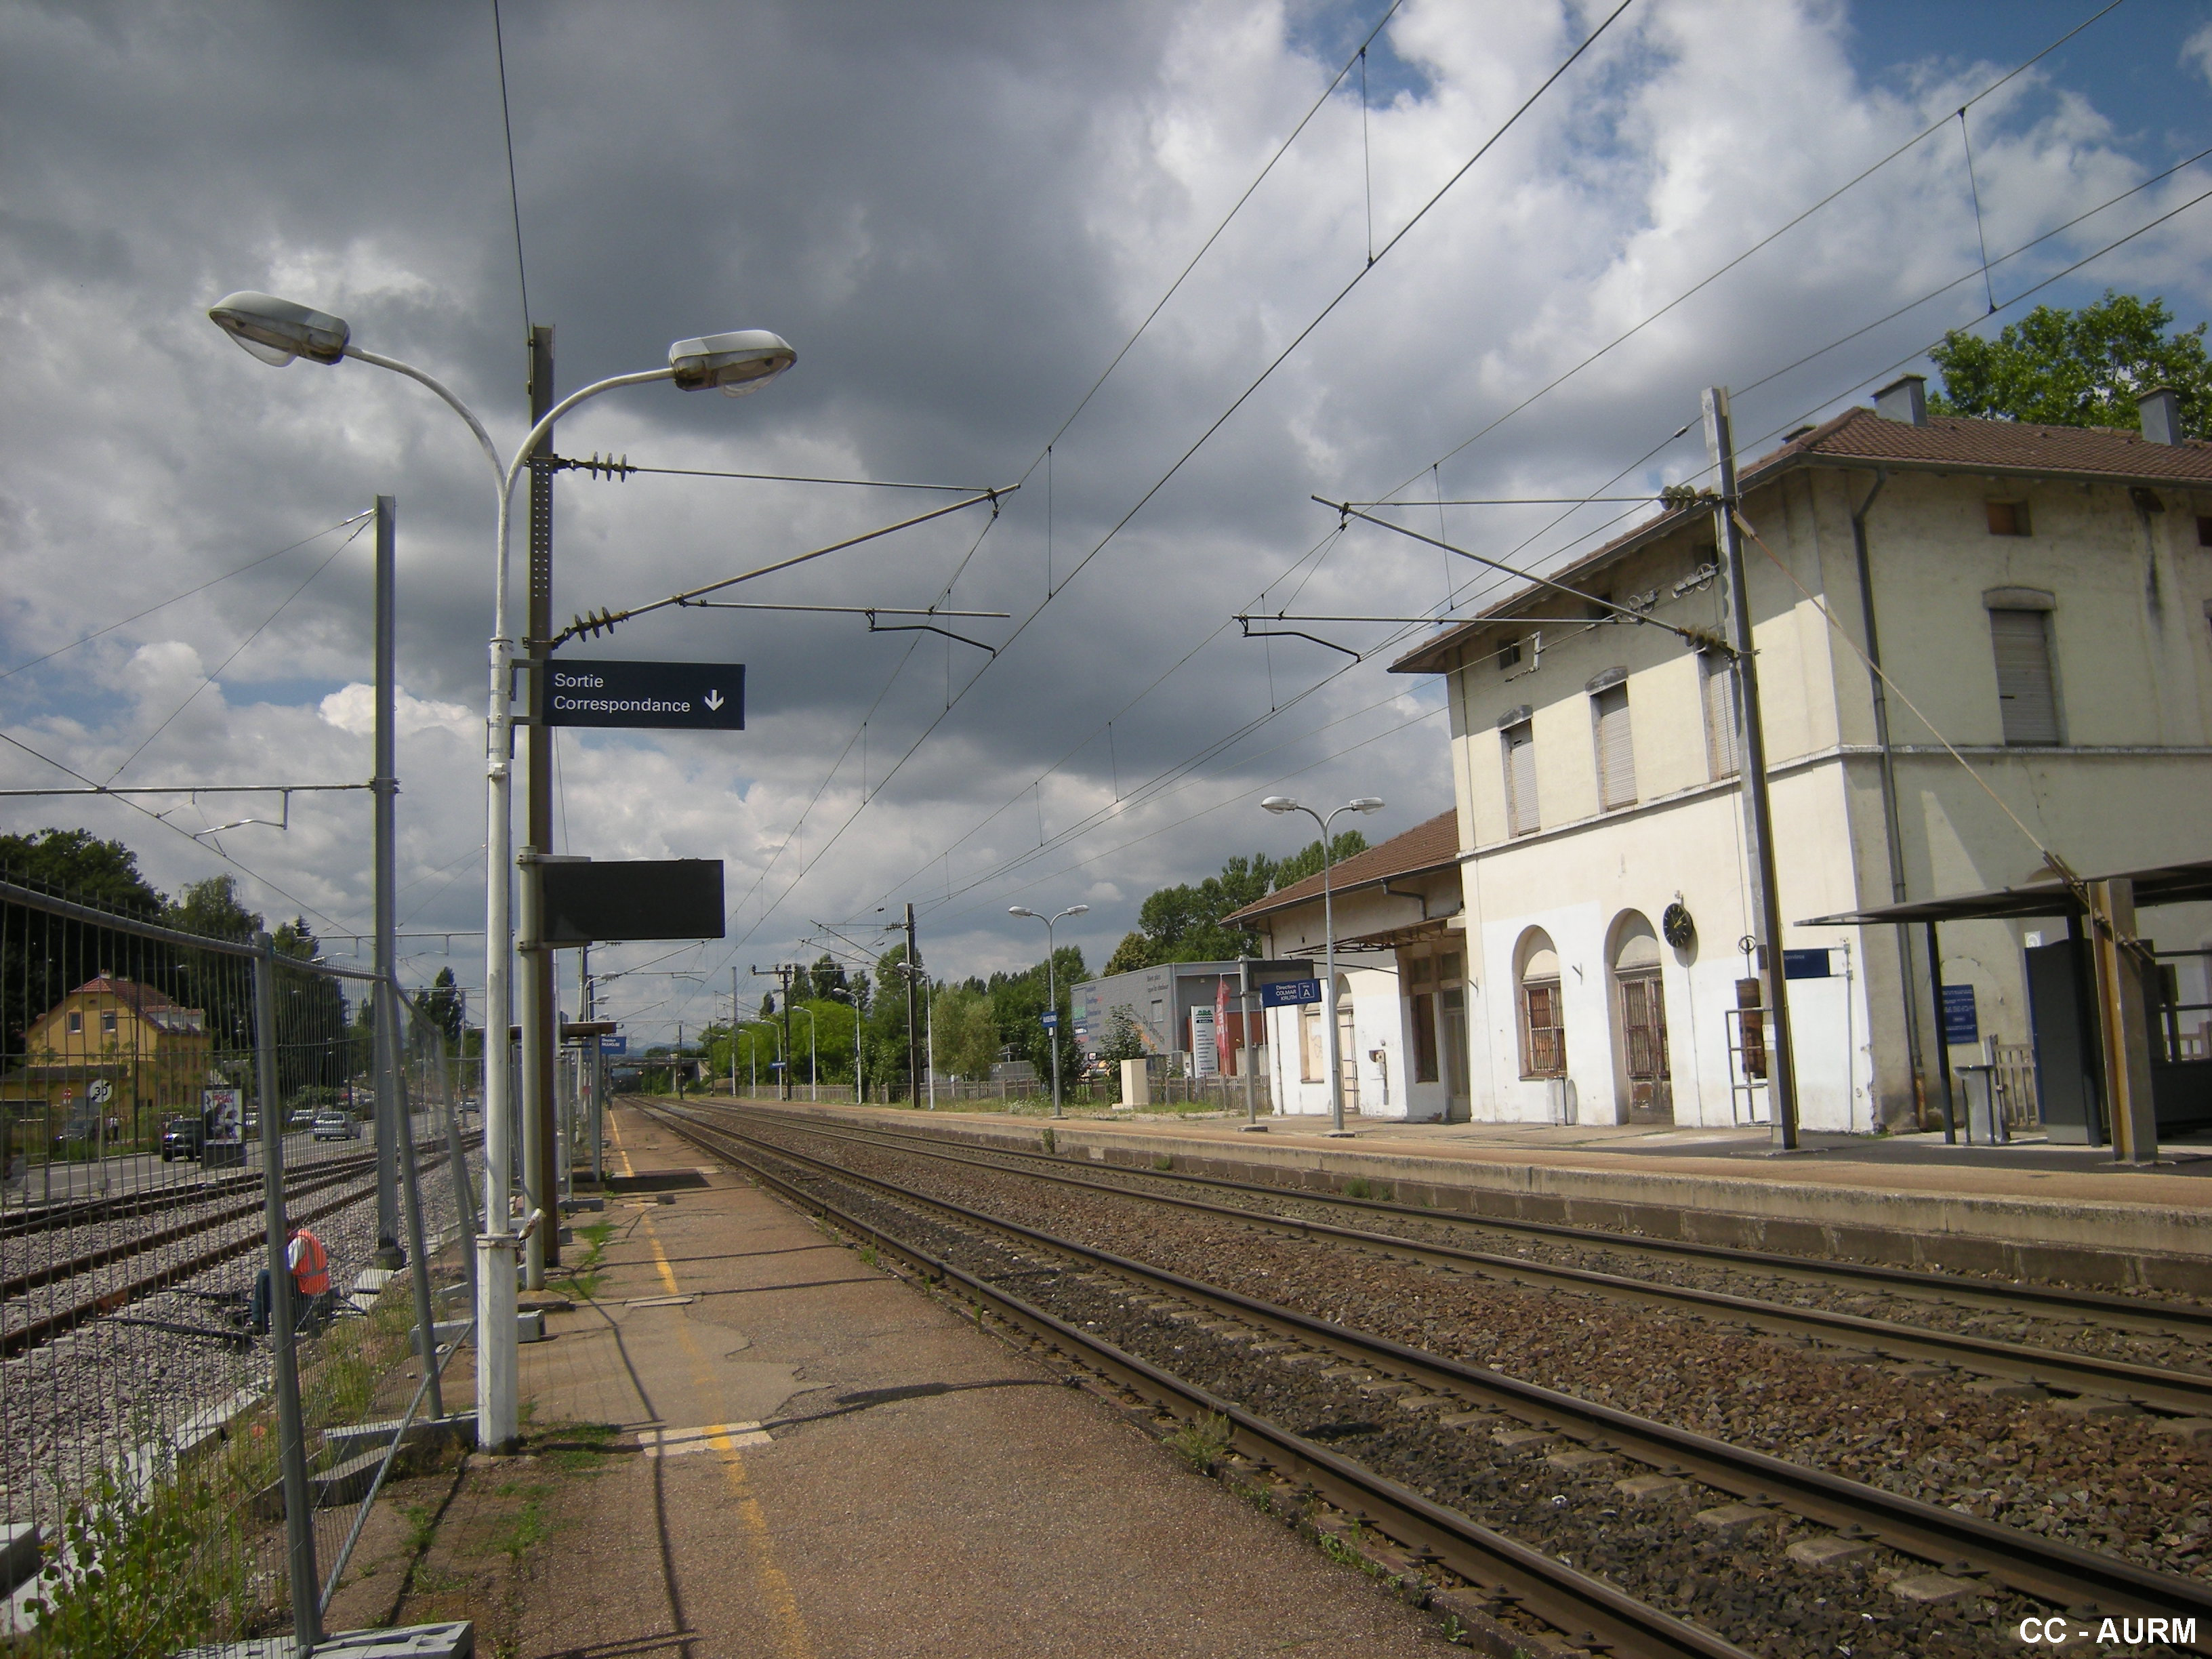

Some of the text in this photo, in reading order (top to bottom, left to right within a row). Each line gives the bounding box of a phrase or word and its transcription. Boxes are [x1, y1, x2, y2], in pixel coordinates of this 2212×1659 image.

[554, 673, 604, 689] Sortie
[554, 695, 691, 714] Correspondance
[1303, 989, 1311, 997] A
[94, 1086, 108, 1096] 30
